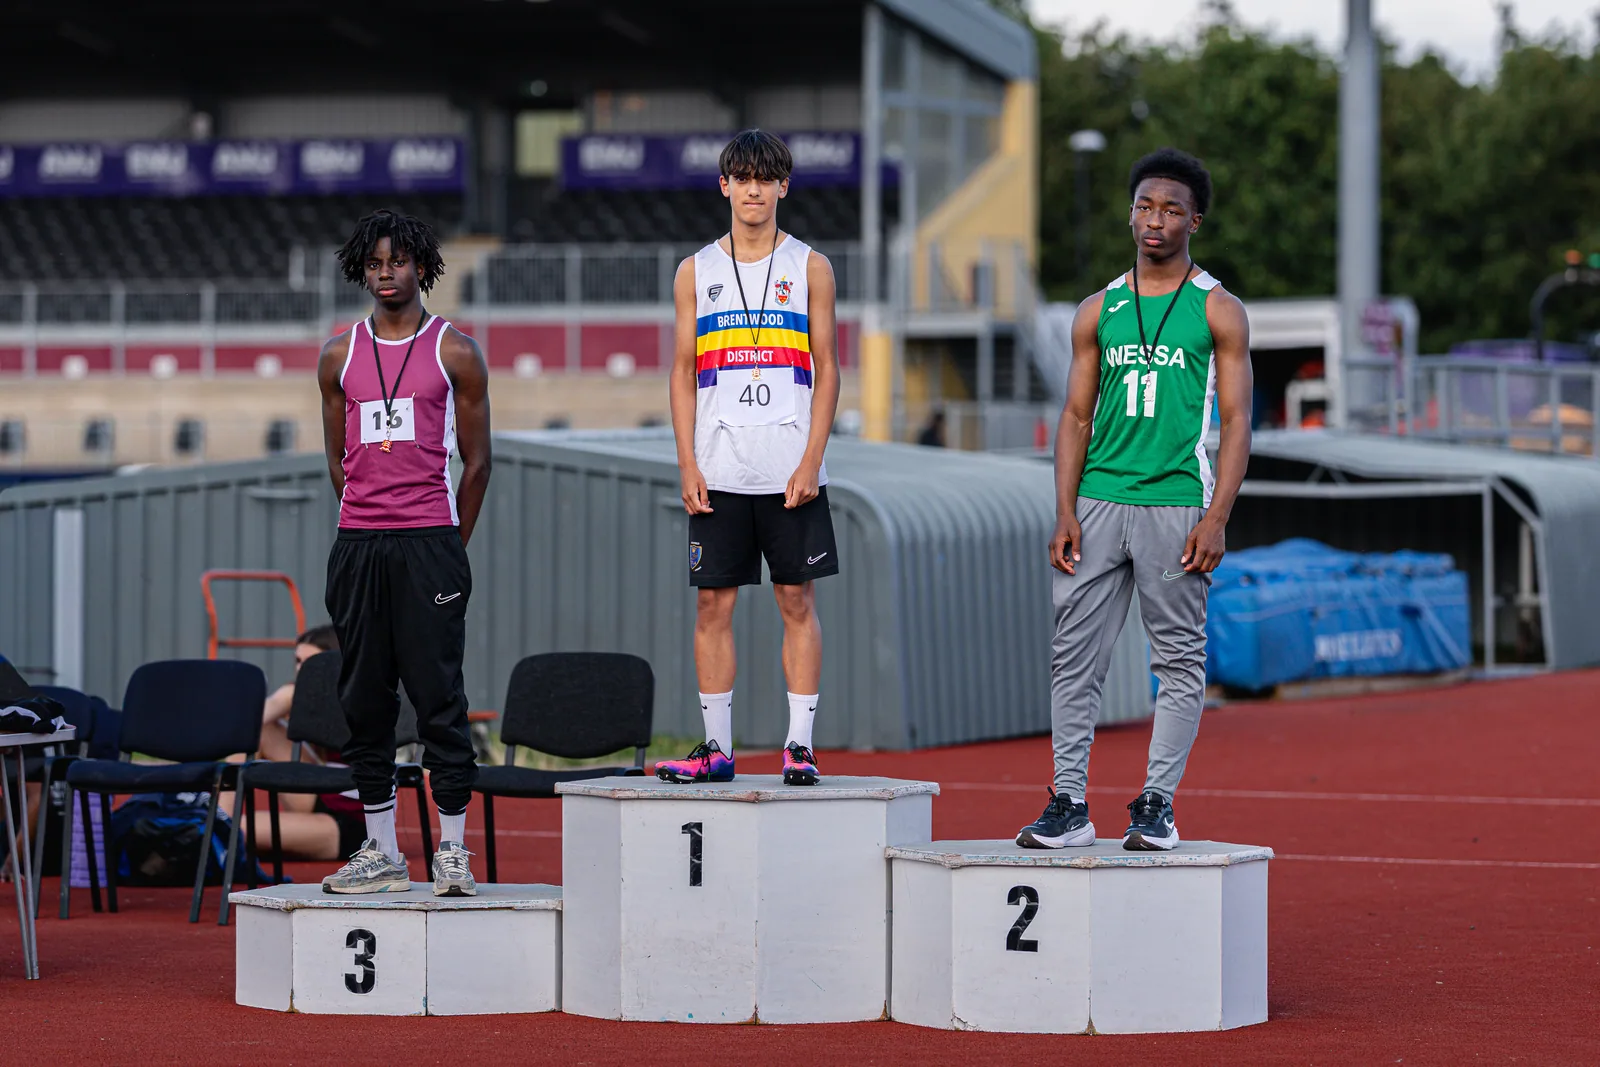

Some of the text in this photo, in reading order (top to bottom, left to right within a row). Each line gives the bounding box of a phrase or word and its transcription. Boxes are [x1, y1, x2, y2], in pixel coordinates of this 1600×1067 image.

[717, 313, 784, 328] BRENTWOOD
[727, 350, 774, 363] DISTRICT
[1105, 344, 1186, 369] WESSA
[738, 383, 771, 407] 40
[1123, 369, 1158, 417] 11
[372, 409, 403, 430] 16
[681, 822, 703, 887] 1
[1006, 885, 1039, 952] 2
[344, 928, 377, 994] 3
